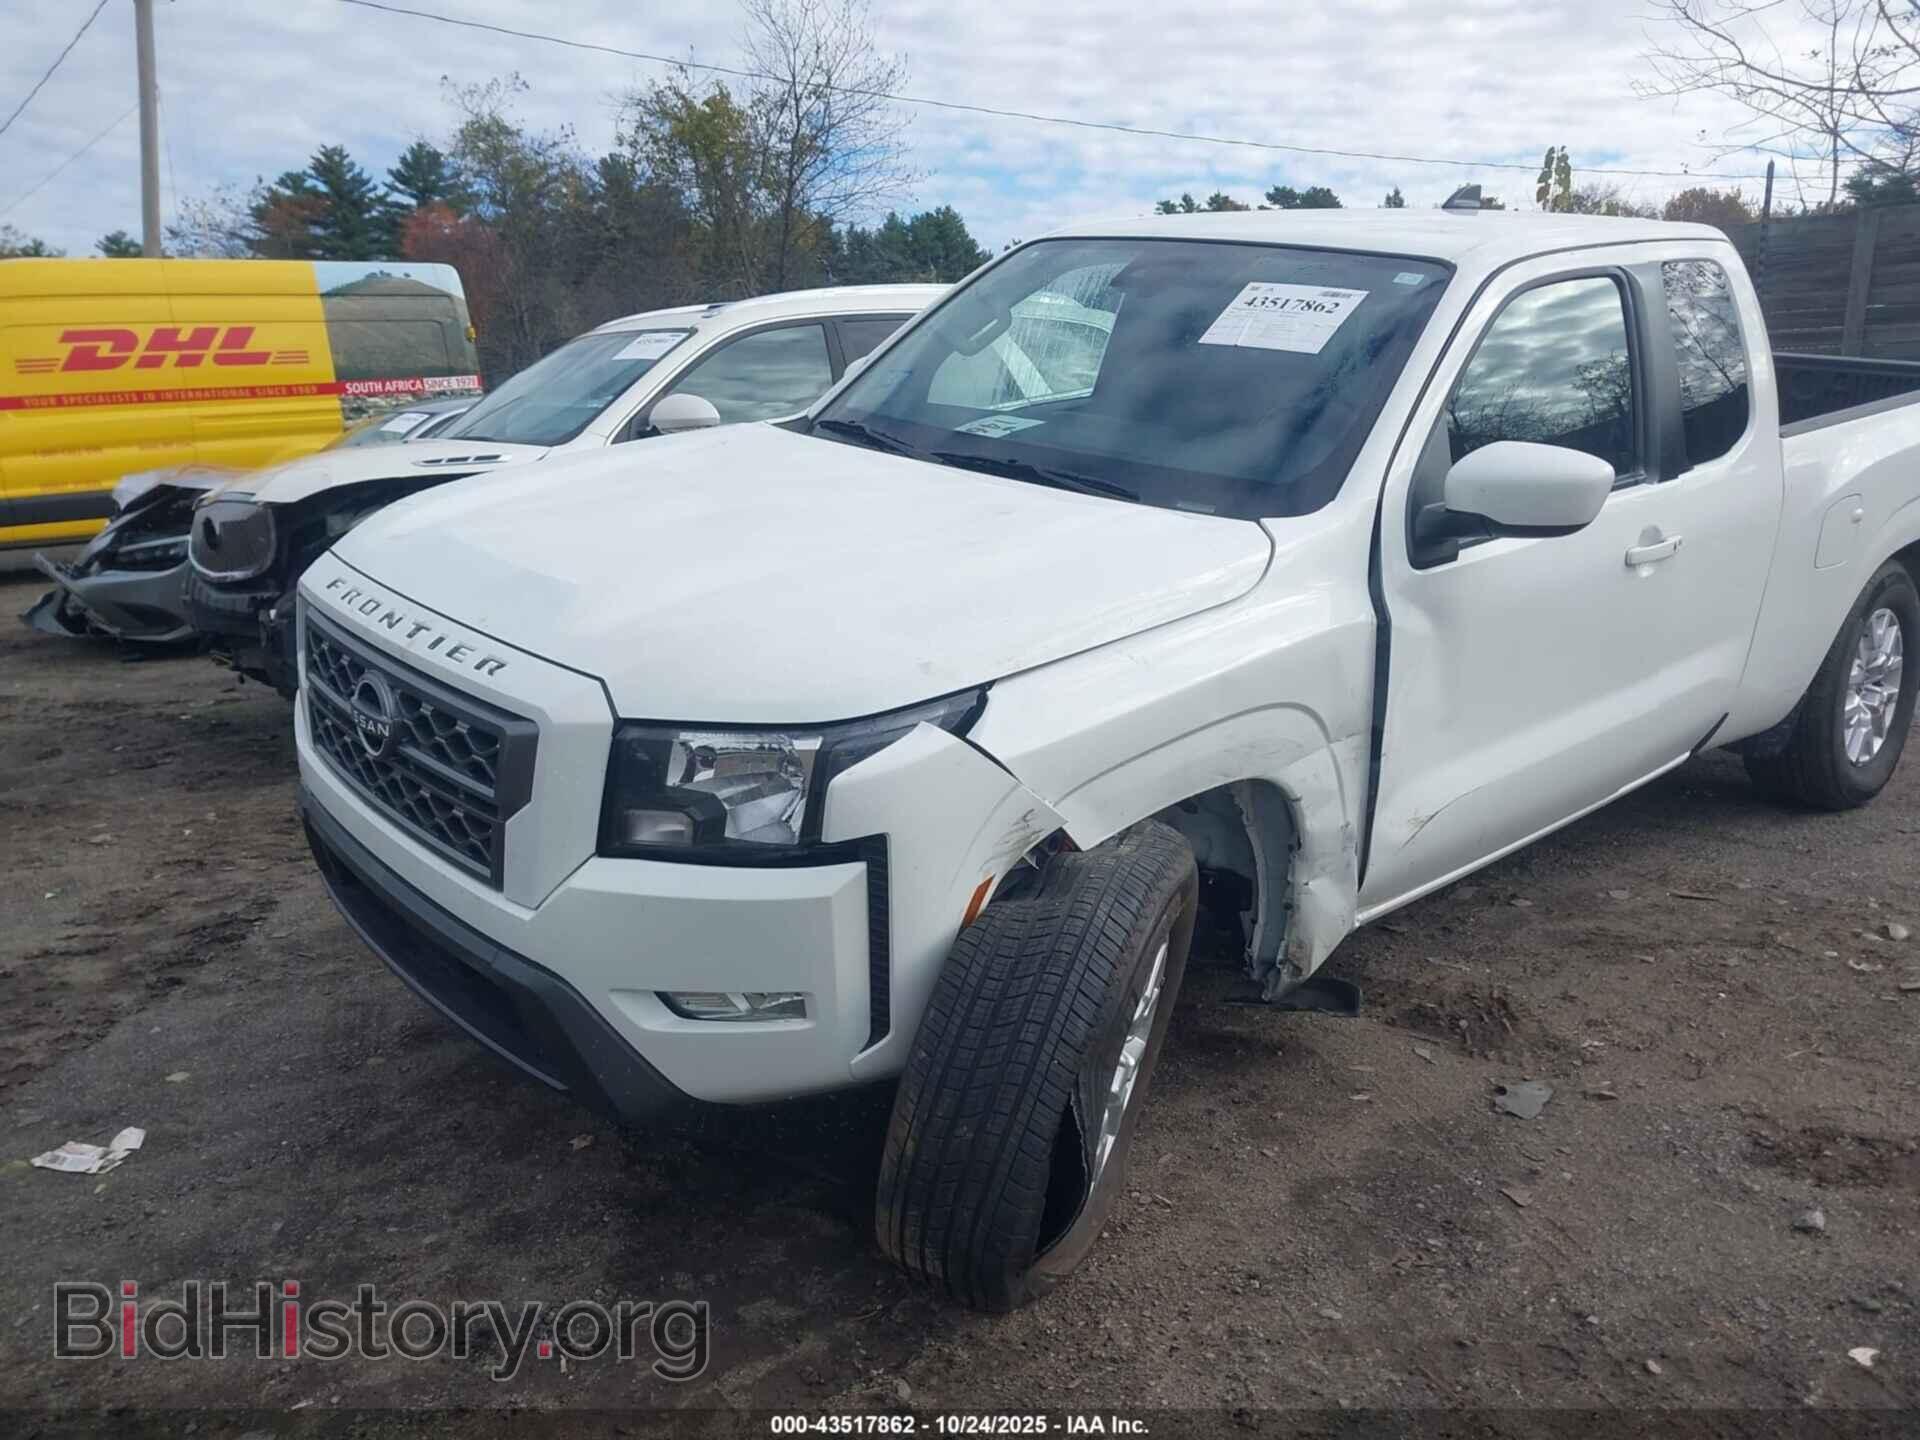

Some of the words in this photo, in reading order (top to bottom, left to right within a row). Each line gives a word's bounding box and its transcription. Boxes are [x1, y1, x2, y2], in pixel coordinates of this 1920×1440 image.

[1243, 296, 1340, 314] 43517862
[58, 326, 273, 372] DHL
[64, 391, 139, 406] SPECIALISTS
[159, 387, 250, 401] INTERNATIONAL
[256, 386, 288, 396] SINCE
[345, 381, 383, 395] SOUTH
[384, 379, 423, 393] AFRICA
[425, 378, 452, 390] SINCE
[326, 577, 508, 677] FRONTIER
